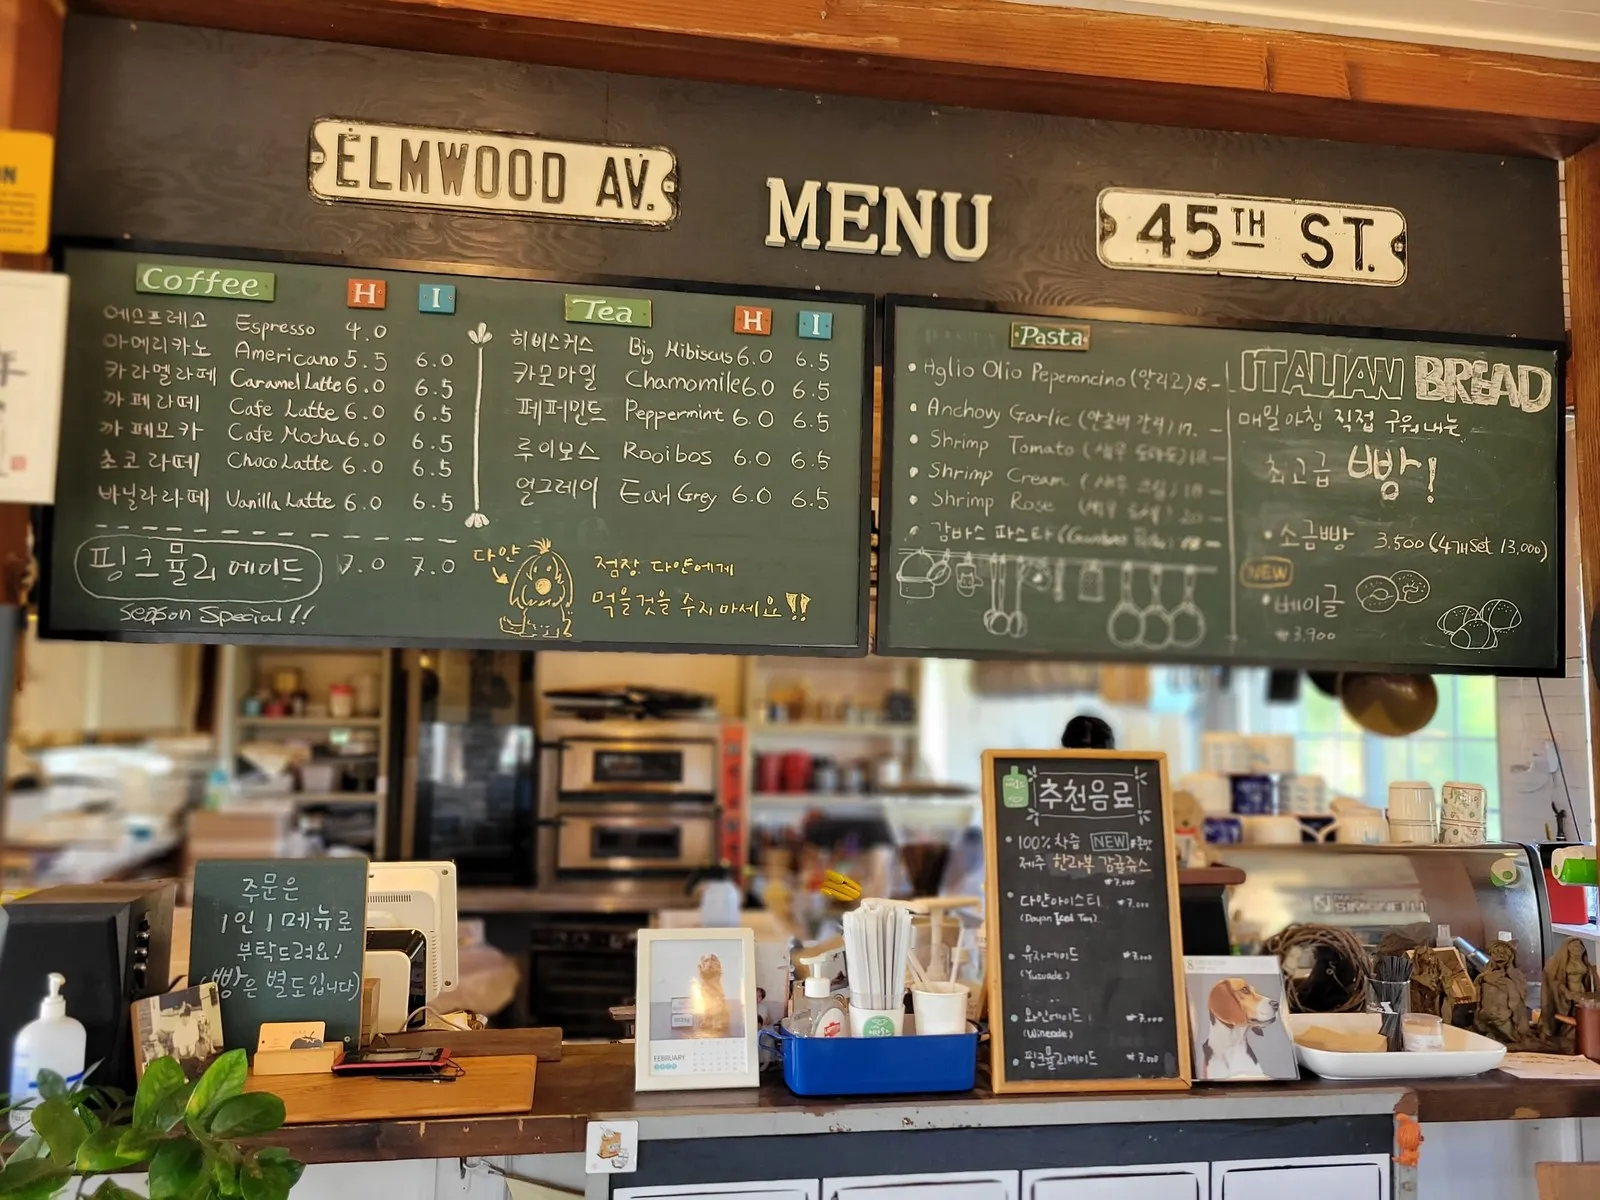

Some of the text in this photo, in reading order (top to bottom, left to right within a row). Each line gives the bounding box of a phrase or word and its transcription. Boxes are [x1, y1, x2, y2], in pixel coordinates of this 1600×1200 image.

[336, 133, 654, 211] ELMWOOD AV.
[765, 177, 992, 262] MENU
[1136, 203, 1375, 272] 45TH ST.
[143, 268, 260, 297] Coffee
[355, 284, 376, 304] H
[432, 289, 440, 307] I
[573, 301, 632, 323] Tea
[104, 307, 387, 341] 에스프레소 Espresso 4.0
[744, 312, 762, 330] H
[811, 314, 820, 334] I
[511, 329, 830, 371] 히비스커스 Big Hibiscus 6.0 6.5
[1020, 326, 1083, 346] Pasta
[104, 335, 453, 371] 아메리카노 Americano 5.5 6.0
[231, 369, 301, 391] Caramel
[305, 373, 341, 392] Latte
[345, 373, 384, 393] 6.0
[415, 378, 453, 399] 6.5
[513, 363, 830, 400] 카모마일 Chamomile 6.0 6.5
[983, 360, 1021, 380] Olio
[1032, 362, 1126, 394] Peperoncino
[1241, 349, 1552, 413] ITALIAN BREAD
[230, 398, 273, 418] Cafe
[285, 401, 339, 422] Latte
[345, 403, 384, 420] 6.0
[414, 405, 451, 423] 6.5
[516, 398, 829, 432] 페퍼민트 Peppermint 6.0 6.5
[928, 397, 1000, 428] Anchovy
[1010, 404, 1071, 427] Garlic
[1239, 405, 1280, 431] 매일
[1286, 405, 1322, 430] 아침
[1335, 409, 1374, 432] 직접
[228, 423, 273, 444] Cafe
[281, 425, 346, 446] Mocha
[347, 431, 385, 447] 6.0
[413, 433, 453, 453] 6.5
[931, 429, 989, 458] Shrimp
[1009, 436, 1074, 457] Tomato
[227, 452, 278, 470] Choco
[281, 453, 333, 472] Latte
[343, 458, 383, 475] 6.0
[413, 459, 451, 477] 6.5
[514, 438, 831, 470] 루이보스 Rooibos 6.0 6.5
[928, 462, 993, 488] Shrimp
[1007, 467, 1068, 486] Cream
[1267, 444, 1438, 503] 최고급 빵!
[226, 489, 281, 510] Vanilla
[285, 490, 336, 510] Latte
[345, 493, 382, 510] 6.0
[413, 494, 453, 511] 6.5
[516, 477, 829, 512] 얼그레이 Earl Grey 6.0 6.5
[931, 491, 994, 516] Shrimp
[931, 523, 986, 542] 감바스
[995, 525, 1052, 542] 파스타
[1280, 519, 1354, 551] 소금빵
[338, 554, 384, 574] 7.0
[413, 556, 455, 575] 7.0
[473, 544, 521, 563] 다얀
[1247, 566, 1289, 581] NEW
[1275, 584, 1345, 617] 베이글
[1040, 778, 1134, 812] 추천음료
[1019, 835, 1050, 850] 100%
[1054, 833, 1080, 850] 착즙
[1094, 836, 1125, 848] NEW
[1019, 855, 1047, 871] 제주
[1052, 853, 1094, 874] 한라봉
[241, 873, 299, 903] 주문은
[237, 941, 342, 962] 부탁드려요!
